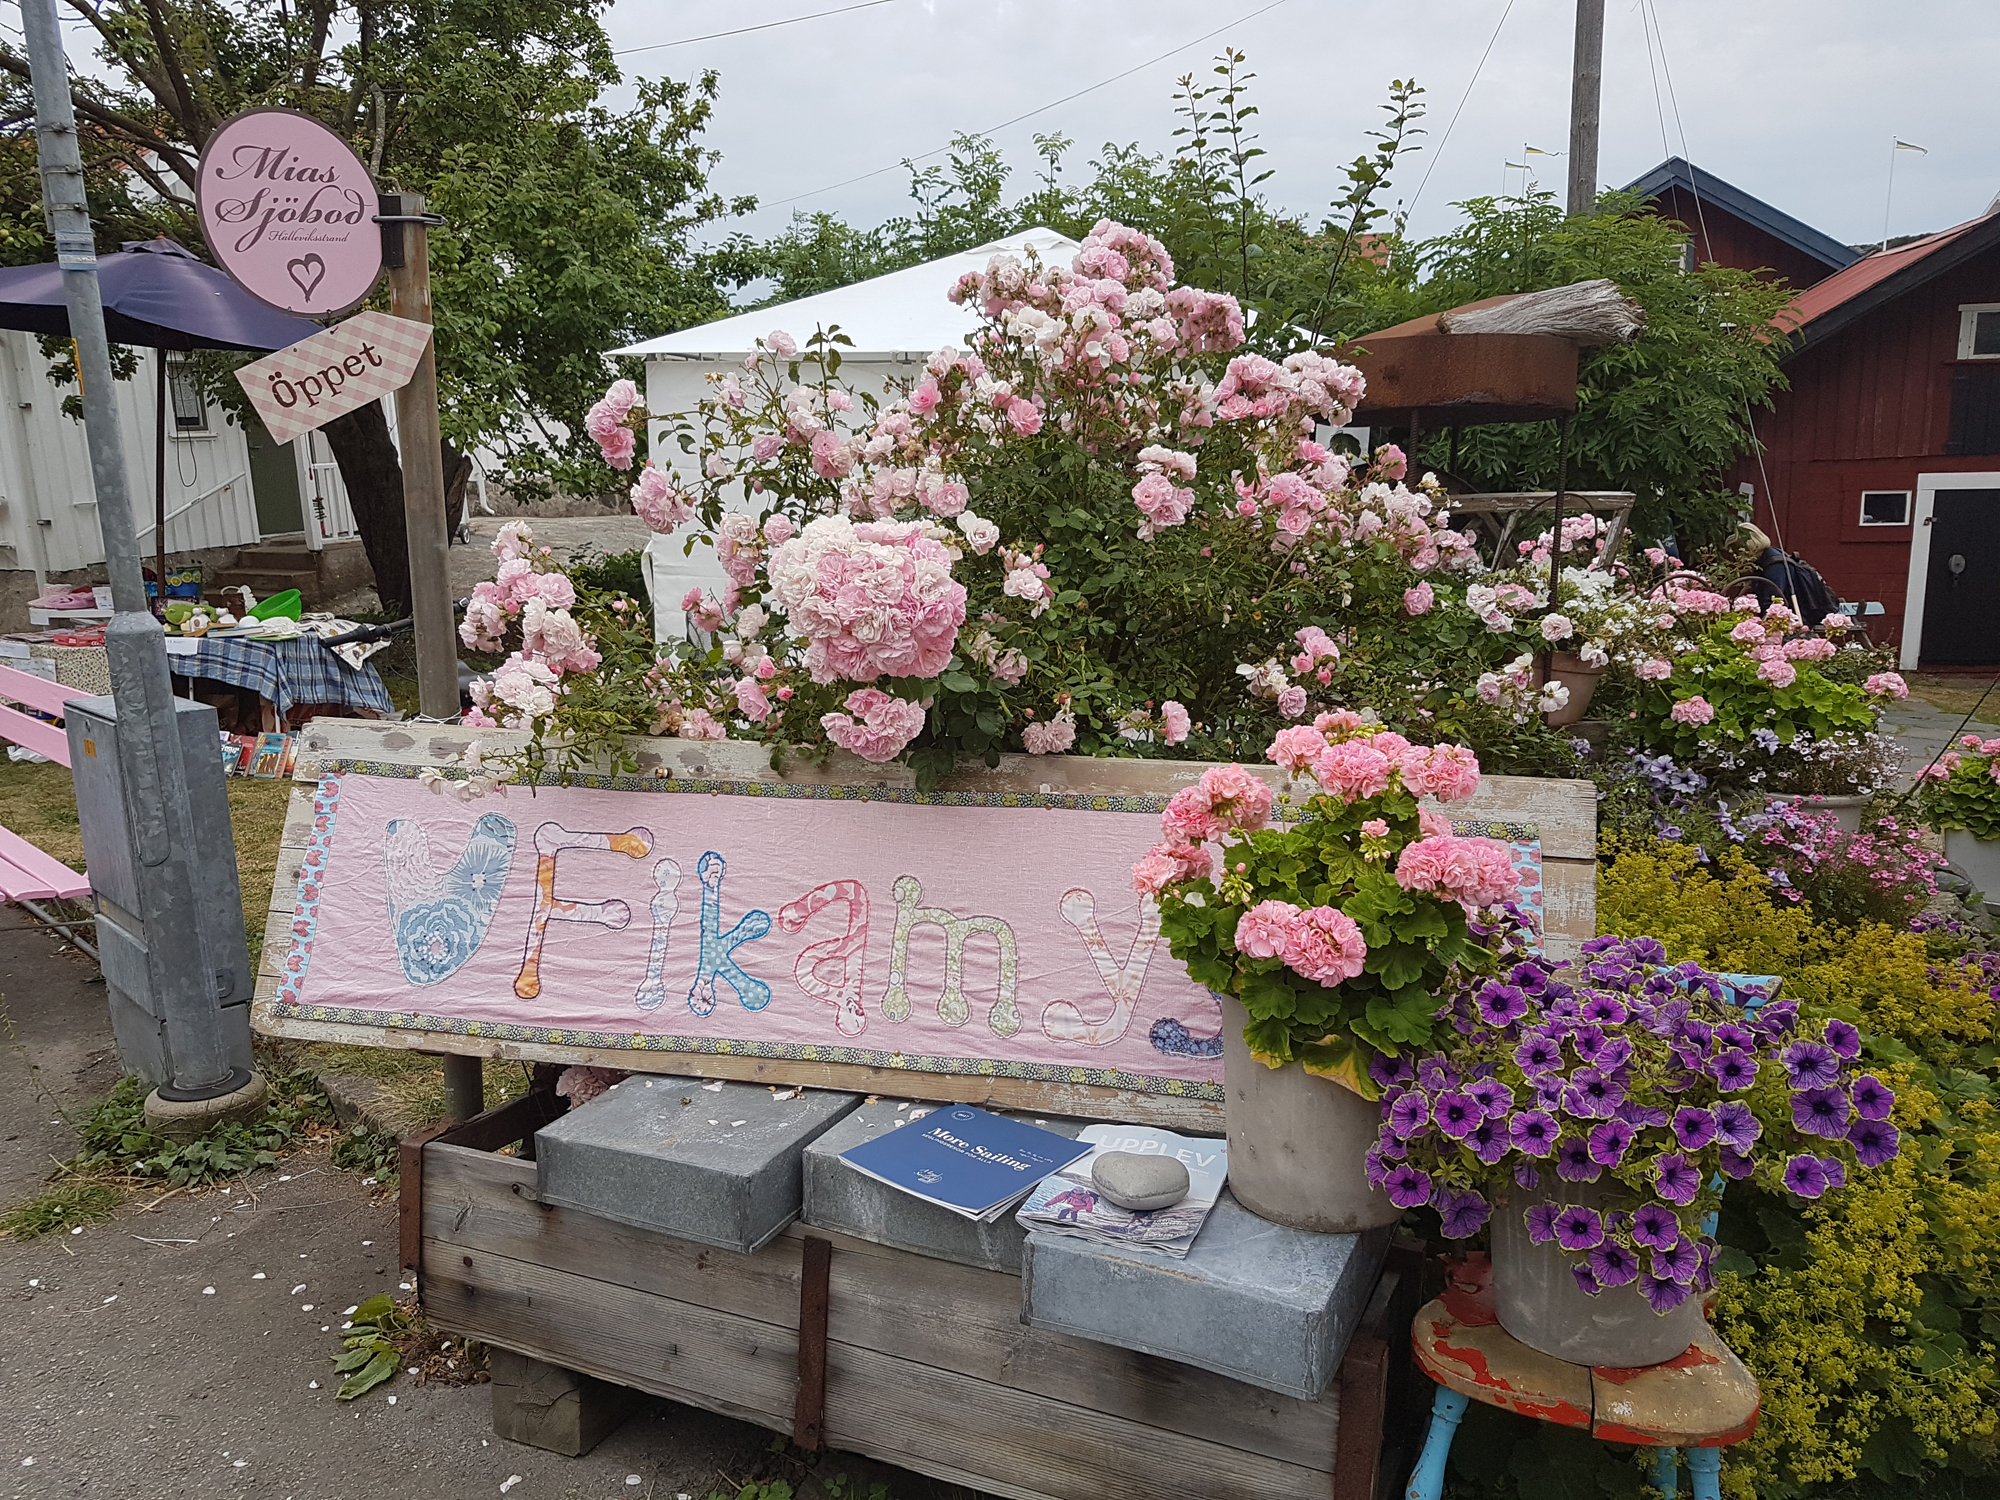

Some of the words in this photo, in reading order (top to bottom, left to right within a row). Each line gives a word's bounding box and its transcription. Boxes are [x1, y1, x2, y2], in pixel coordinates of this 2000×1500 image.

[215, 145, 340, 183] Mias
[214, 184, 374, 253] Sjöbod
[267, 228, 350, 244] Hälleviksstrand
[268, 341, 384, 409] Öppet
[927, 1126, 970, 1149] More
[970, 1144, 1032, 1172] Sailing
[977, 1156, 992, 1165] ALLA
